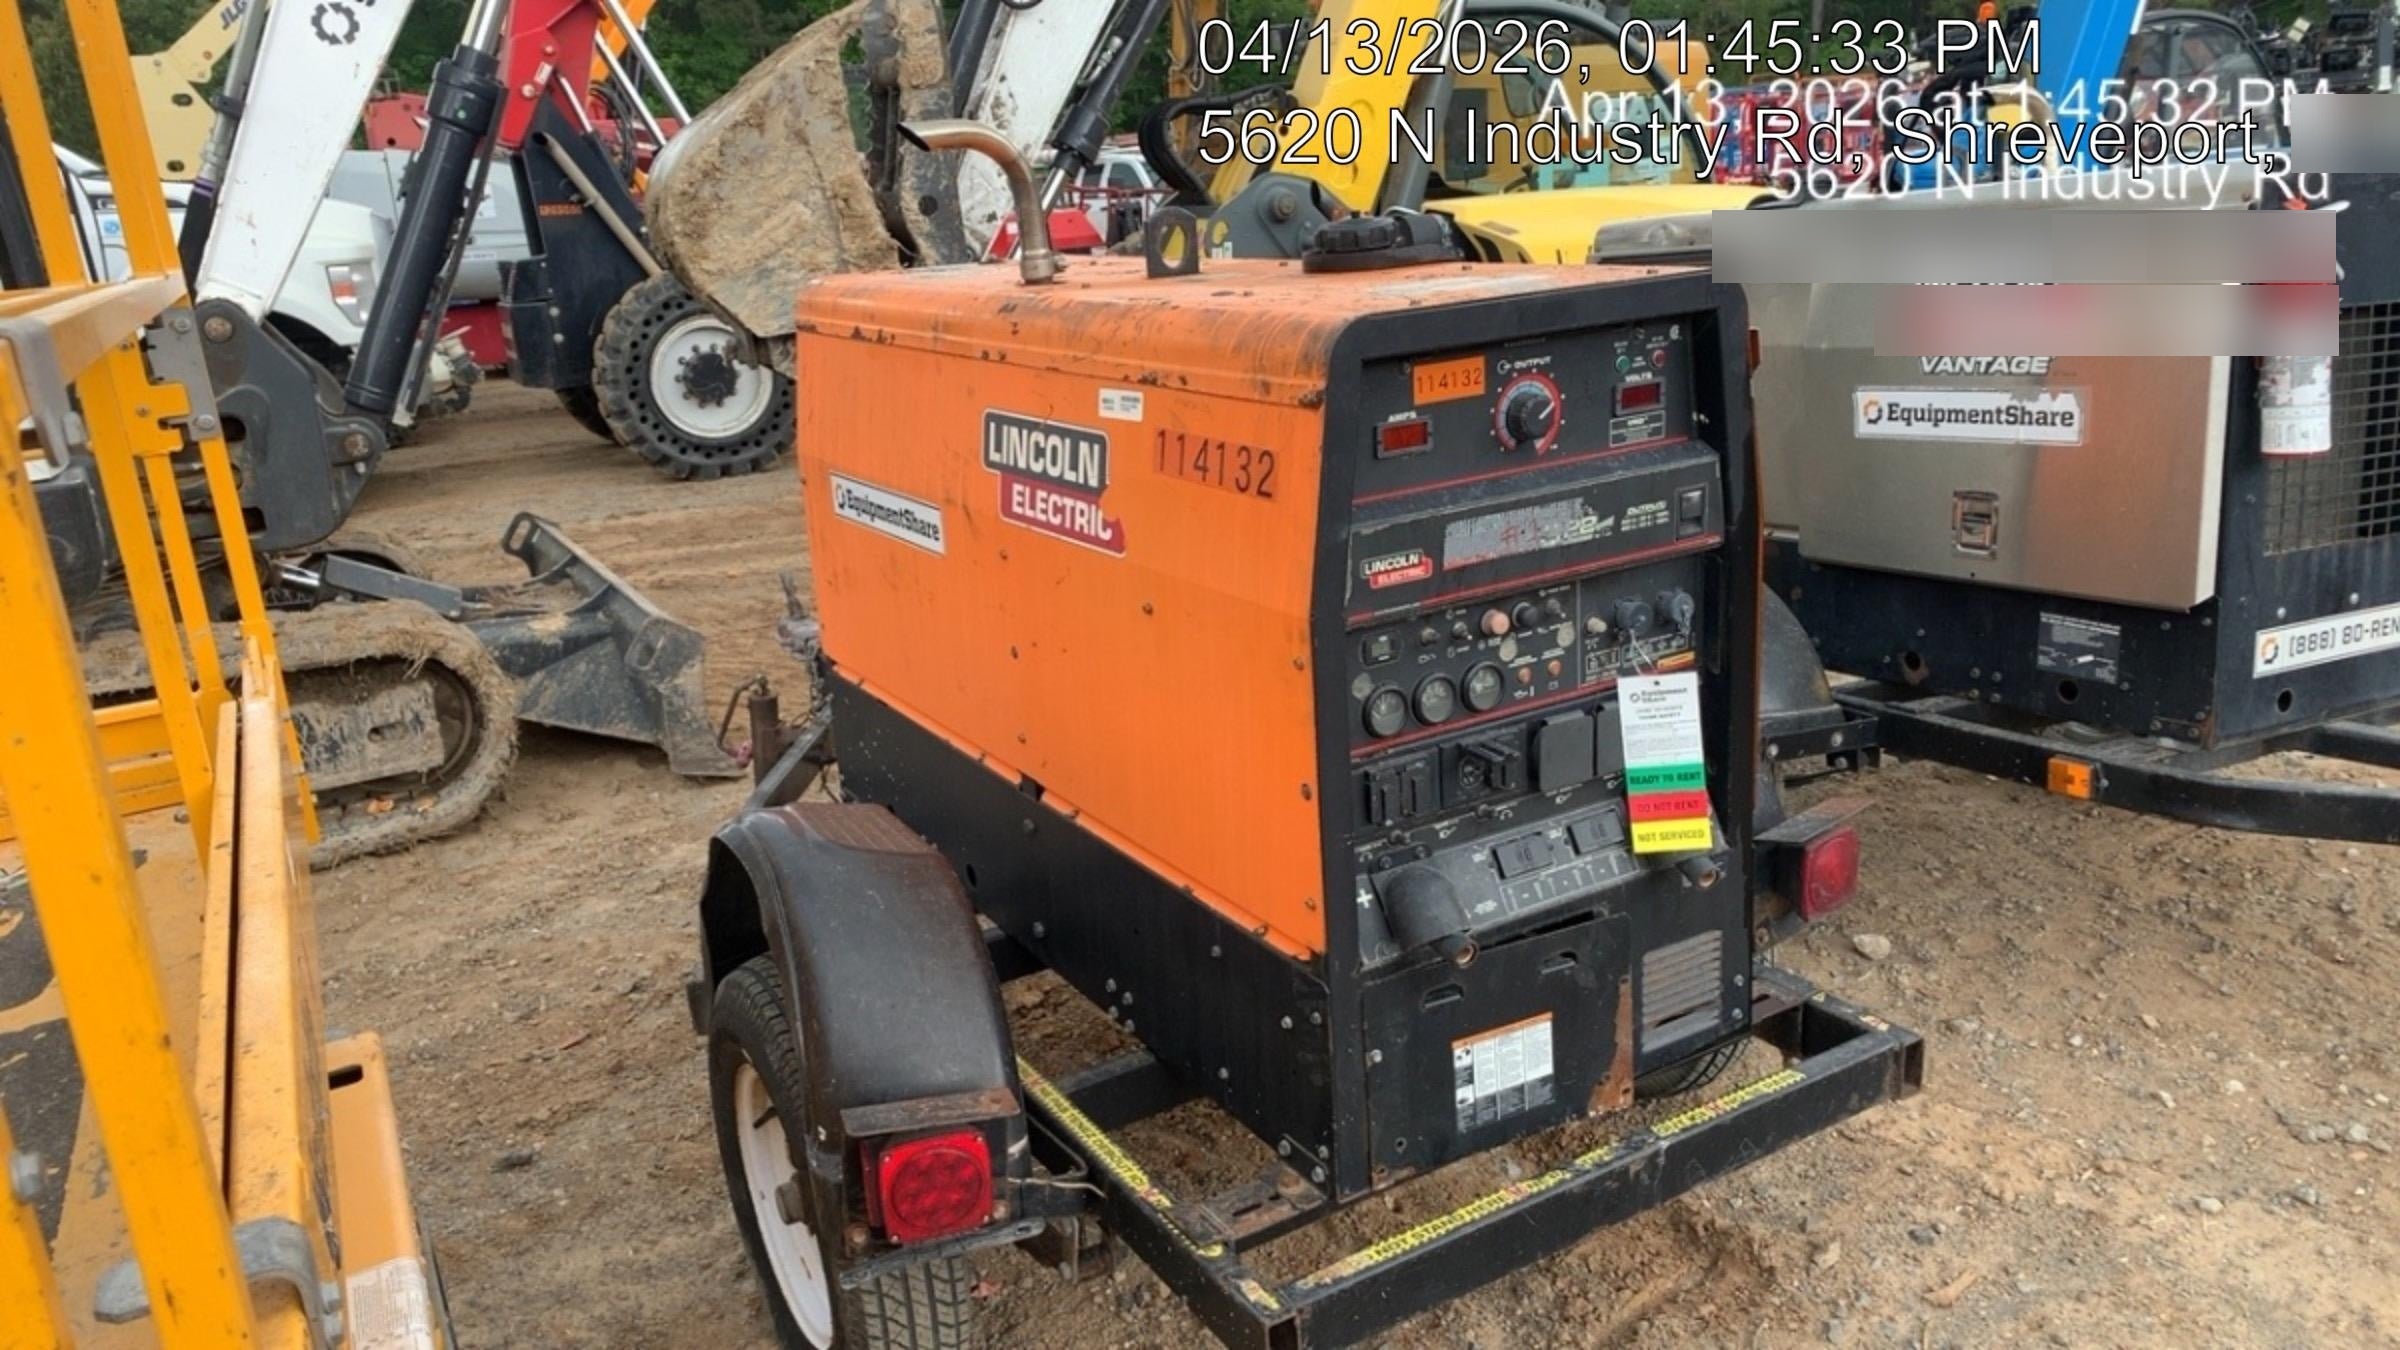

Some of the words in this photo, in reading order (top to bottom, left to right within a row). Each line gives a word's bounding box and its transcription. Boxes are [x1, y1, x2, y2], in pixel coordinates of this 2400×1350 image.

[1921, 356, 2050, 376] VANTAGE
[1417, 367, 1482, 394] 114132
[1887, 403, 2075, 428] EquipmentShare
[988, 421, 1100, 488] LINCOLN
[1157, 428, 1276, 499] 114132
[846, 489, 941, 542] EquipmentShare
[1364, 552, 1420, 575] LINCOLN
[2289, 627, 2337, 658] (888)
[1629, 774, 1660, 785] READY
[1662, 773, 1675, 783] TO
[1676, 771, 1701, 782] RENT
[1637, 803, 1650, 813] DO
[1675, 799, 1699, 810] RENT
[1637, 833, 1656, 843] NOT
[1659, 829, 1705, 841] SERVICED
